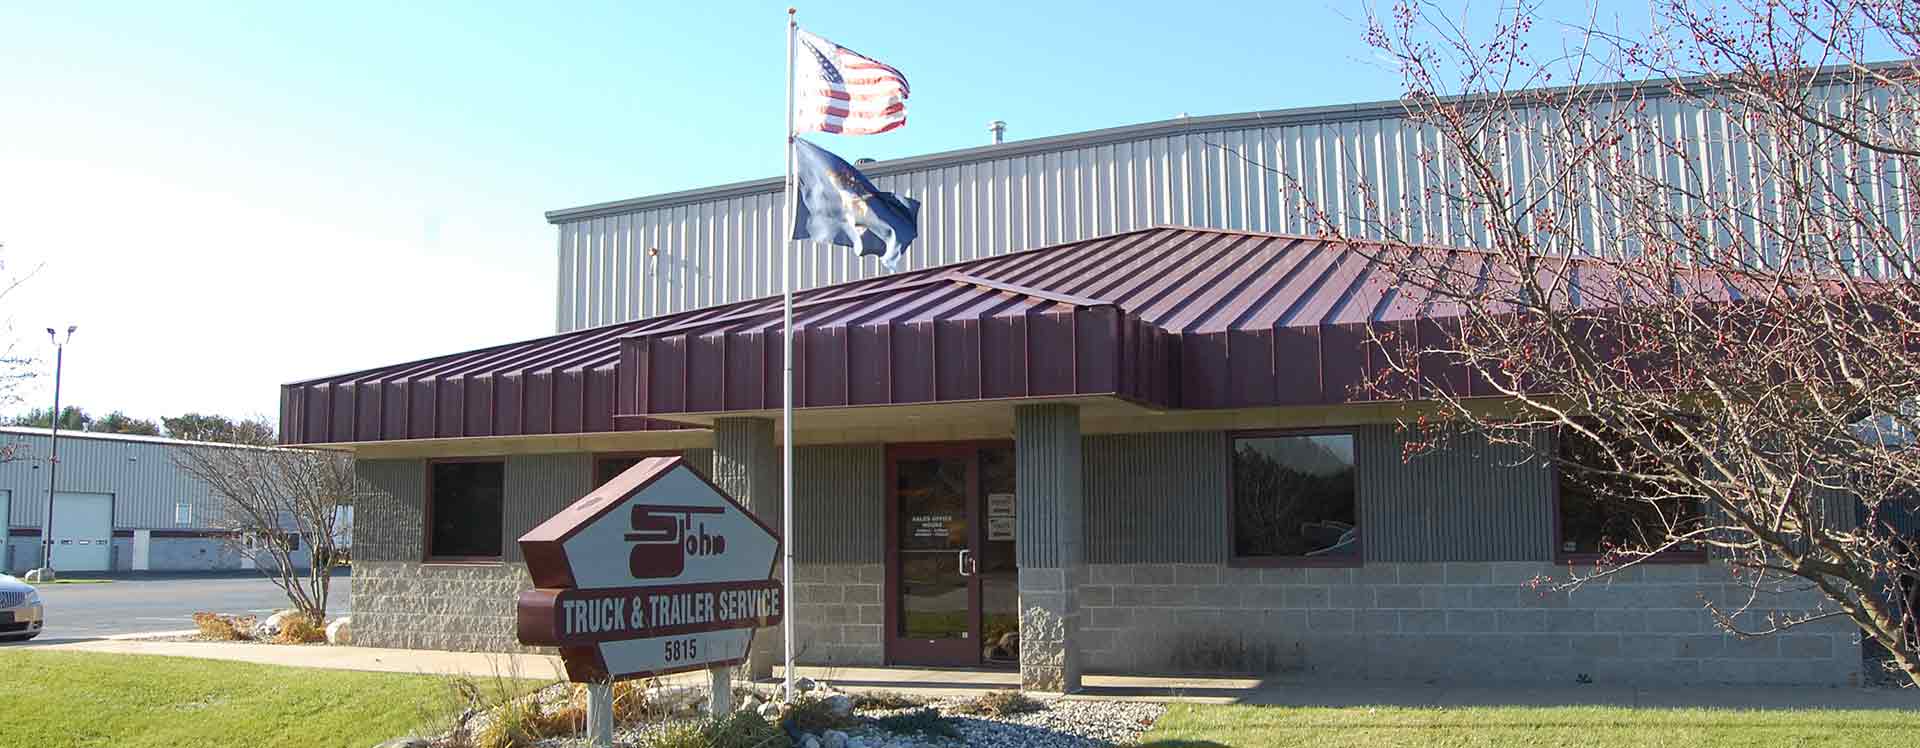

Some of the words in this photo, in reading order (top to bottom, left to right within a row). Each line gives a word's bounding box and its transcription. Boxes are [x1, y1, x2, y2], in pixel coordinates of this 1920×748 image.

[563, 599, 625, 634] TRUCK
[631, 596, 644, 628] &
[648, 593, 714, 627] TRAILER
[719, 588, 780, 621] SERVICE
[664, 639, 697, 662] 5815
